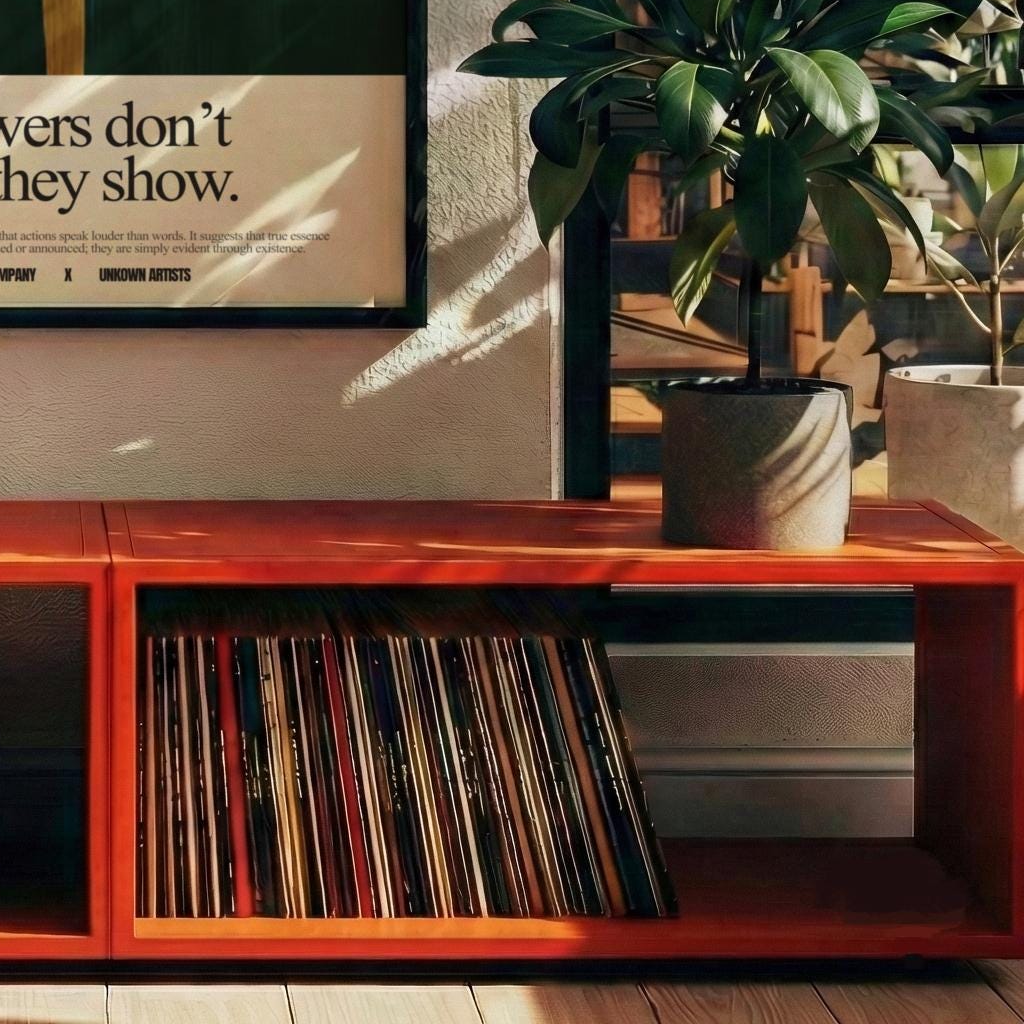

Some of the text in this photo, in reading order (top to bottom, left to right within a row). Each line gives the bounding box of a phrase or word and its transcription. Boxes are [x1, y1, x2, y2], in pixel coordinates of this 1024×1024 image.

[105, 100, 232, 147] don’t
[103, 155, 238, 202] show.
[20, 230, 56, 241] actions
[59, 230, 88, 243] speak
[91, 230, 124, 241] louder
[126, 230, 149, 241] than
[151, 230, 186, 241] words.
[189, 230, 197, 241] It
[199, 232, 243, 243] suggests
[246, 230, 265, 241] that
[268, 232, 288, 241] true
[290, 232, 330, 241] essence
[15, 245, 27, 254] or
[28, 243, 88, 255] announced;
[91, 243, 114, 256] they
[116, 245, 132, 254] are
[134, 243, 169, 256] simply
[172, 243, 210, 254] evident
[212, 243, 253, 256] through
[255, 243, 306, 254] existence.
[64, 267, 72, 282] X
[99, 267, 146, 282] UNKOWN
[148, 267, 191, 282] ARTISTS
